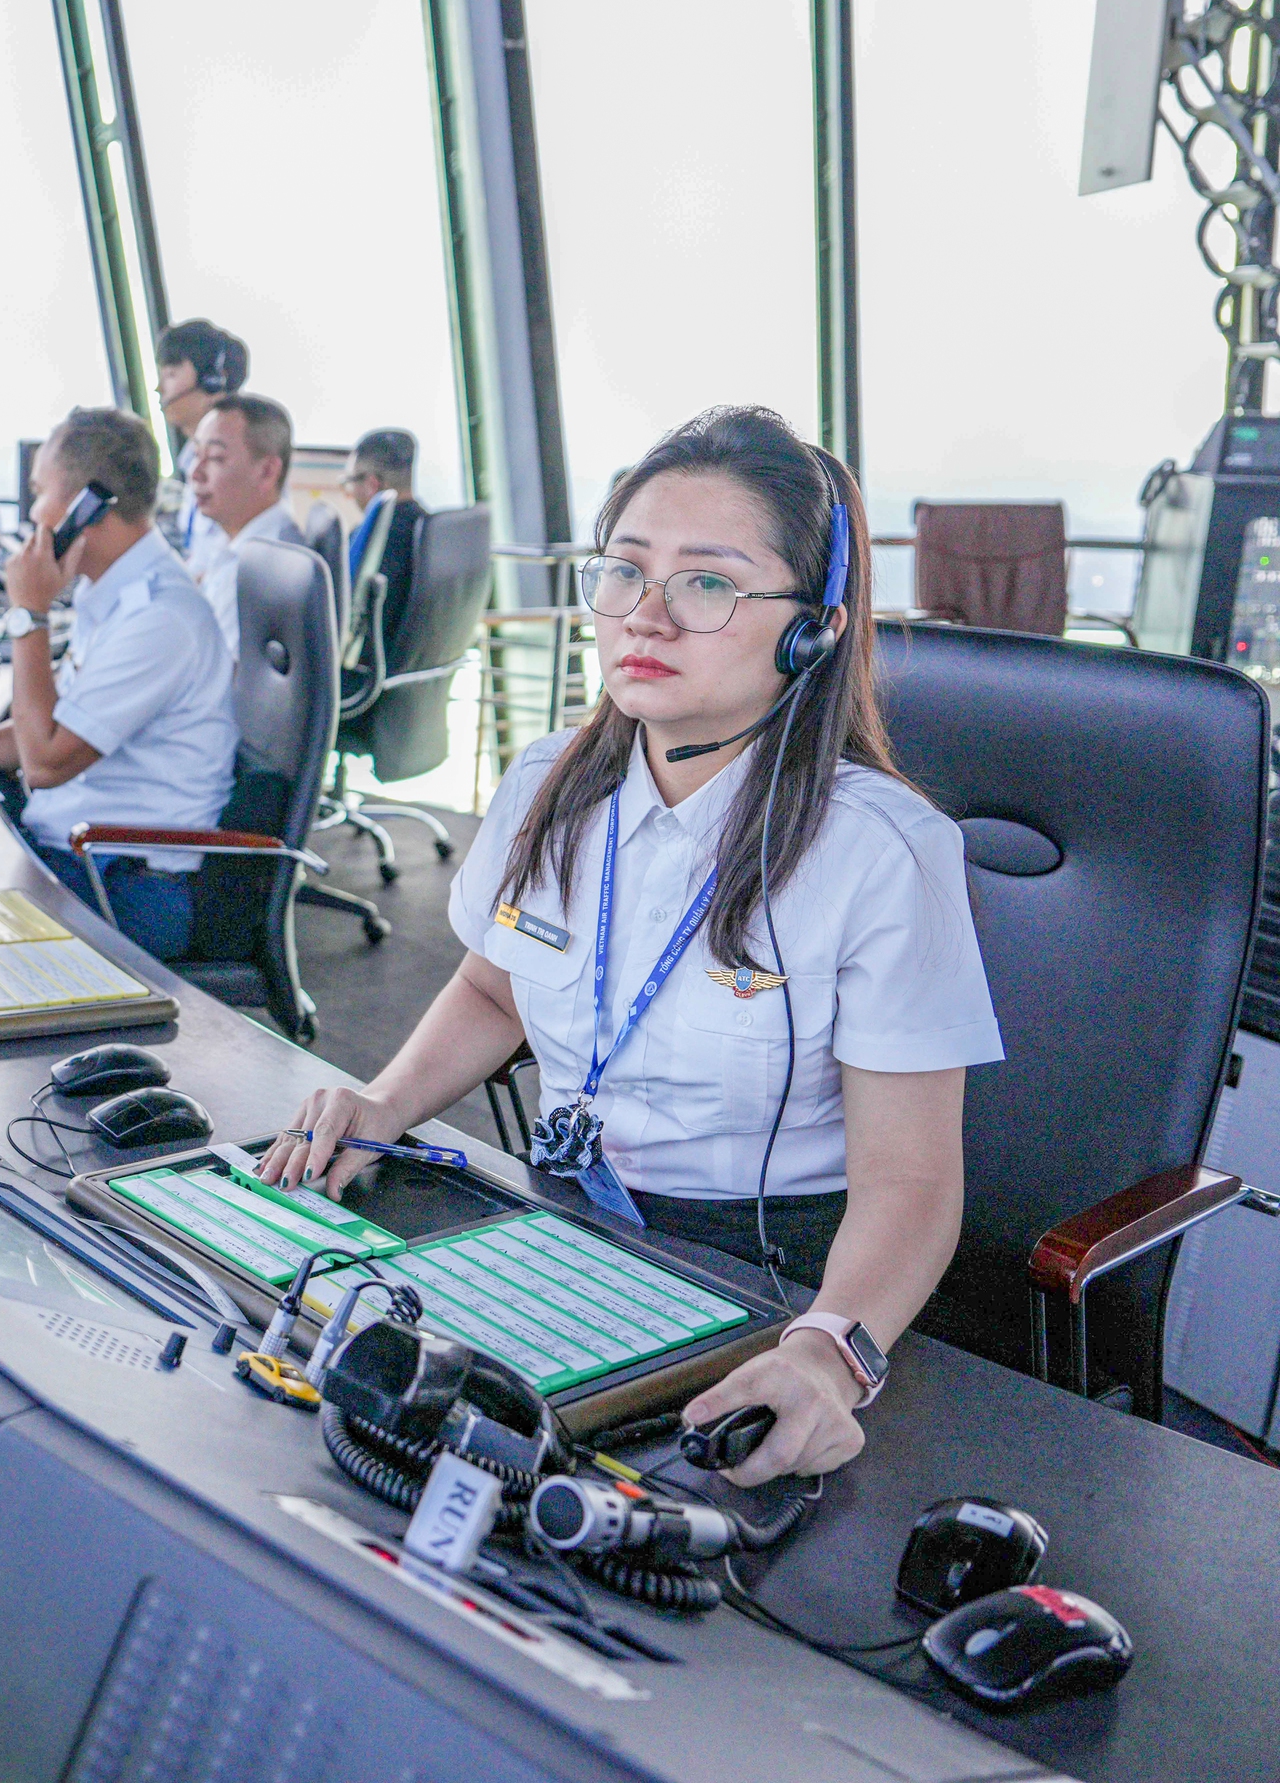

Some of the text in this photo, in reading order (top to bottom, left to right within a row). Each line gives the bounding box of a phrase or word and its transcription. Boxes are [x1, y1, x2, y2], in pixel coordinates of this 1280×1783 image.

[604, 837, 614, 881] MANAGEMENT
[602, 883, 610, 910] TRAFFIC
[544, 930, 558, 943] OANH
[598, 925, 607, 955] VIETNAM
[659, 955, 674, 974] TỔNG
[682, 925, 692, 936] TY
[428, 1481, 479, 1557] RUN
